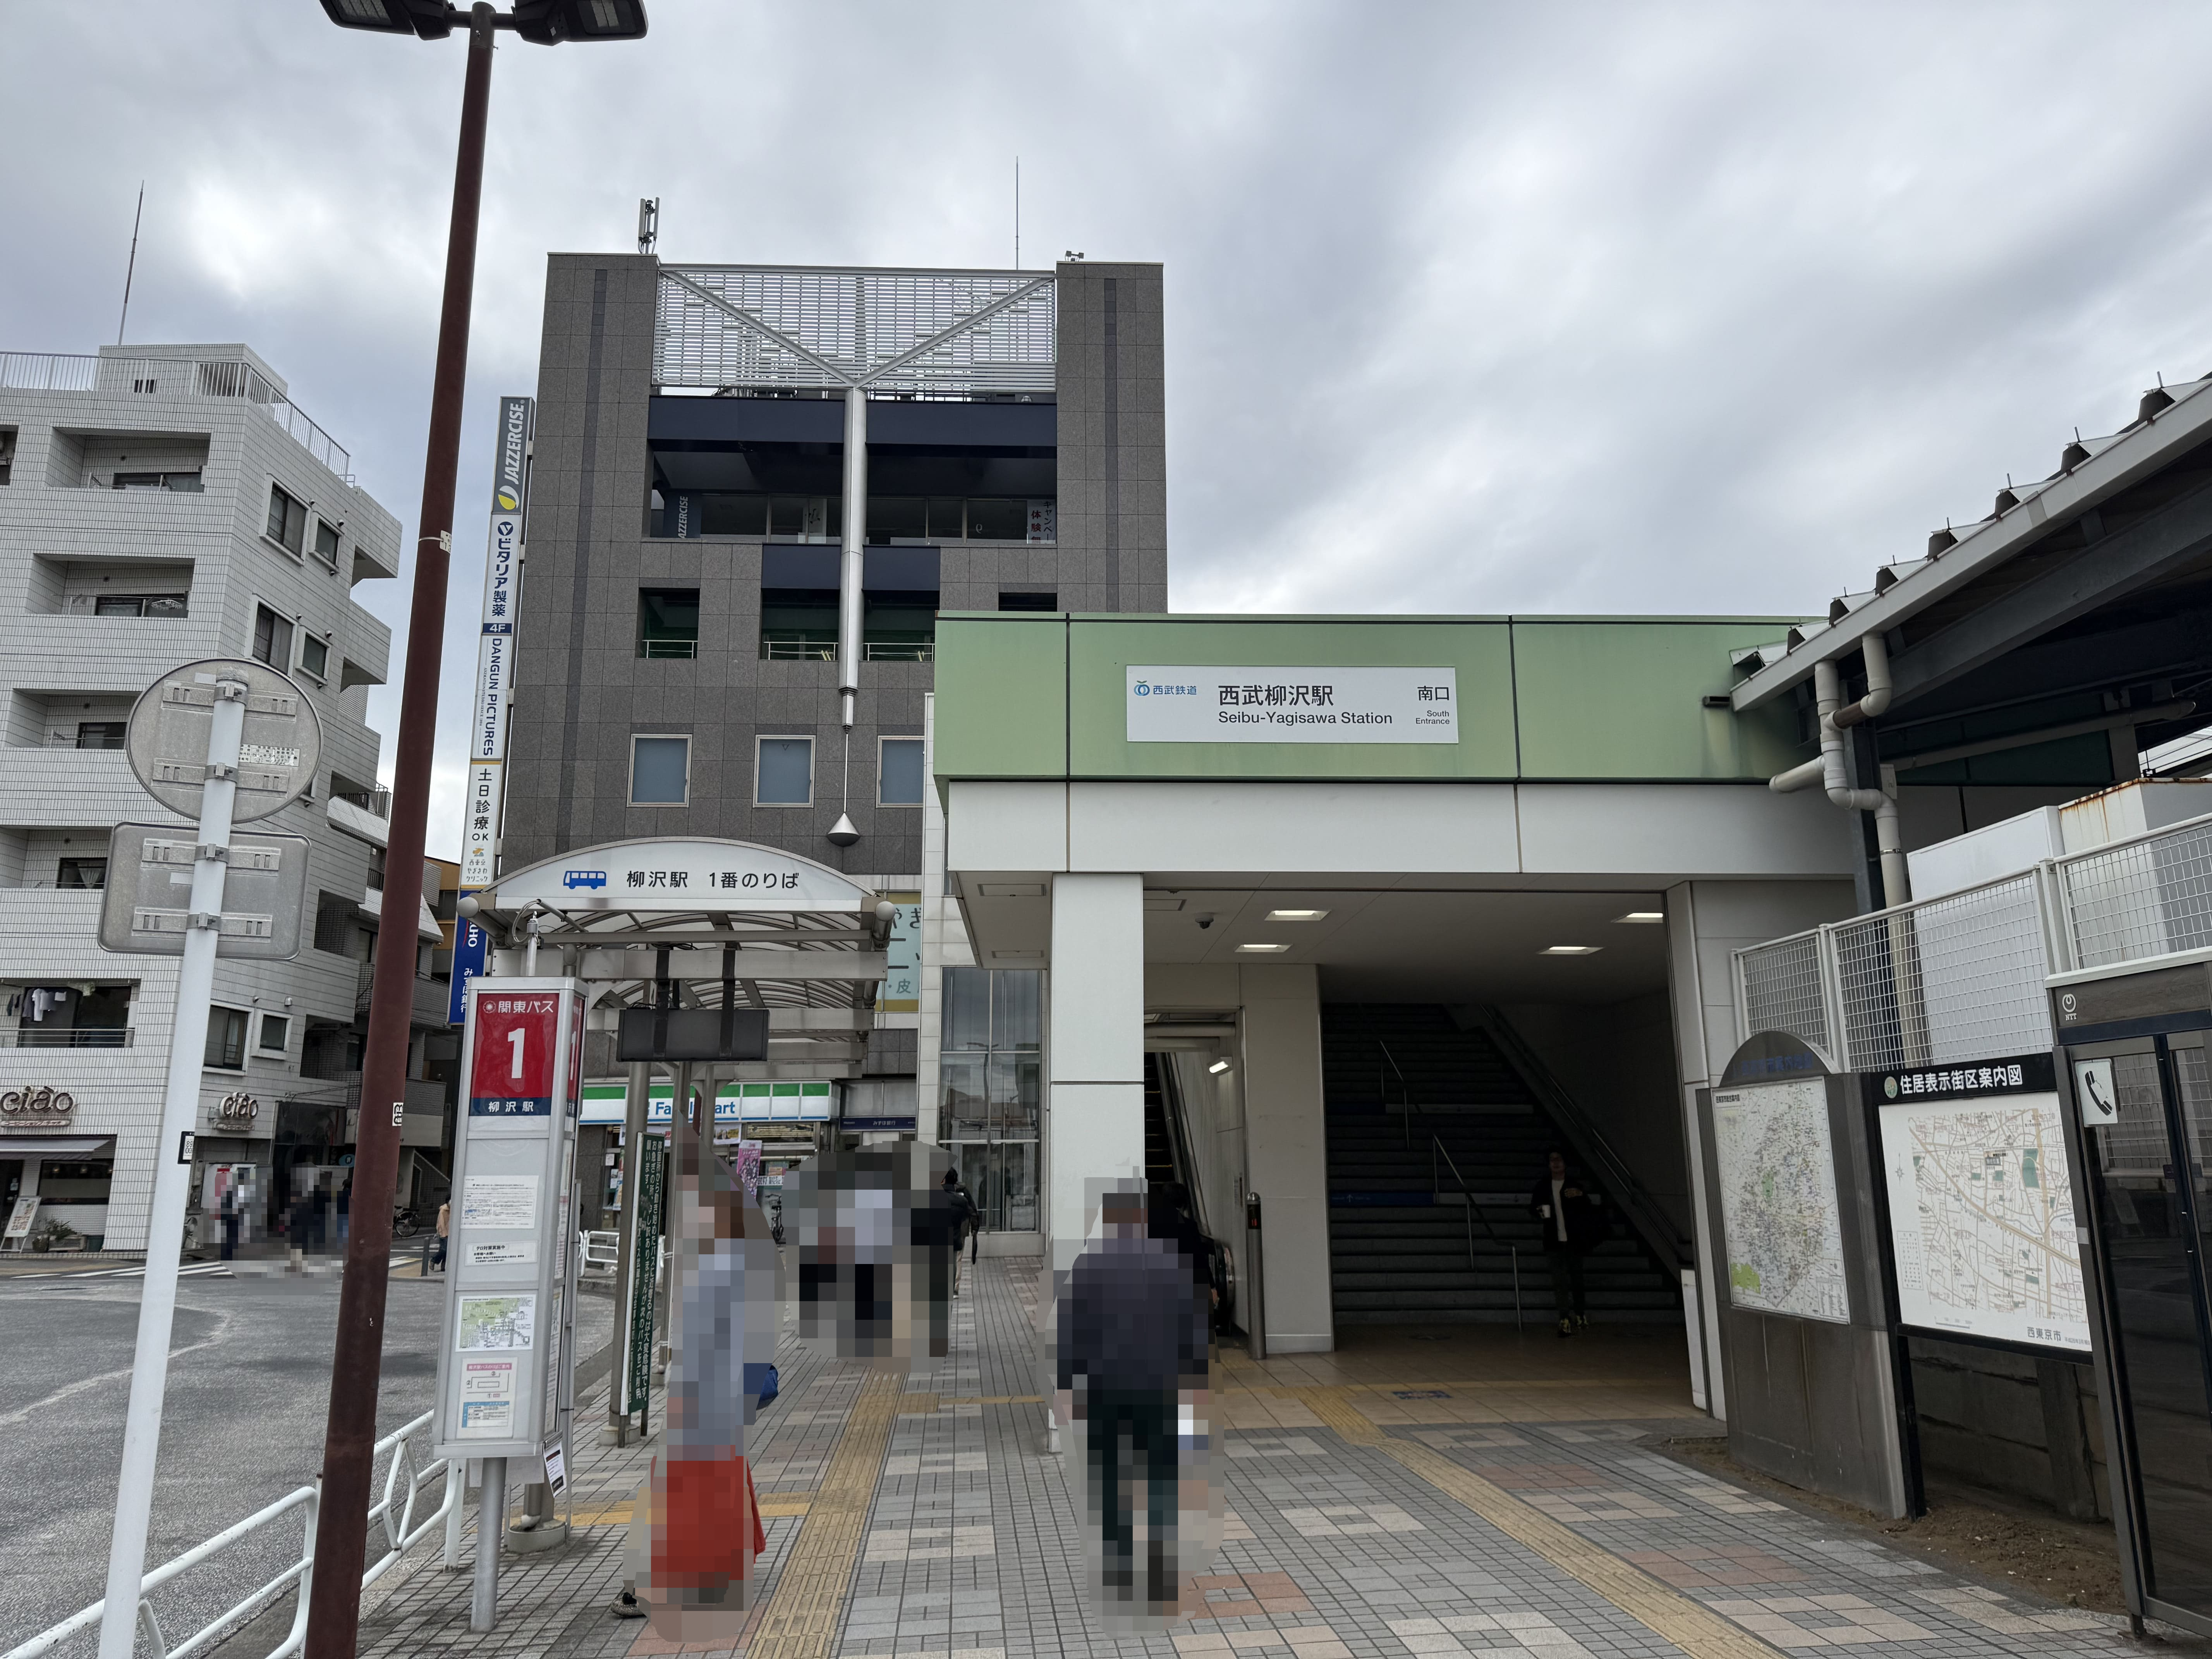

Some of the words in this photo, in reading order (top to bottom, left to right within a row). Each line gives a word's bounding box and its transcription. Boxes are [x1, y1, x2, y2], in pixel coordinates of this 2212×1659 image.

[504, 403, 524, 485] JAZZERCISE
[678, 496, 688, 539] AZZERCISE
[491, 538, 512, 617] ビタリア製薬
[489, 624, 506, 632] 4F
[488, 638, 502, 689] DANGUN
[1153, 685, 1197, 696] 西武鉄道
[1218, 685, 1333, 707] 西武柳沢駅
[1417, 686, 1449, 701] 南口
[483, 694, 498, 756] PICTURES
[1218, 711, 1336, 726] Seibu-Yagisawa
[1341, 711, 1393, 724] Station
[627, 870, 689, 888] 柳沢駅
[709, 871, 800, 890] 1番のりば
[498, 1000, 554, 1013] 関東バス
[2065, 1013, 2077, 1021] NTT
[507, 1027, 526, 1079] 1
[1900, 1064, 2023, 1095] 住居表示街区案内図
[488, 1101, 534, 1113] 柳沢駅
[655, 1101, 735, 1115] Falart
[2027, 1326, 2061, 1341] 西東京市
